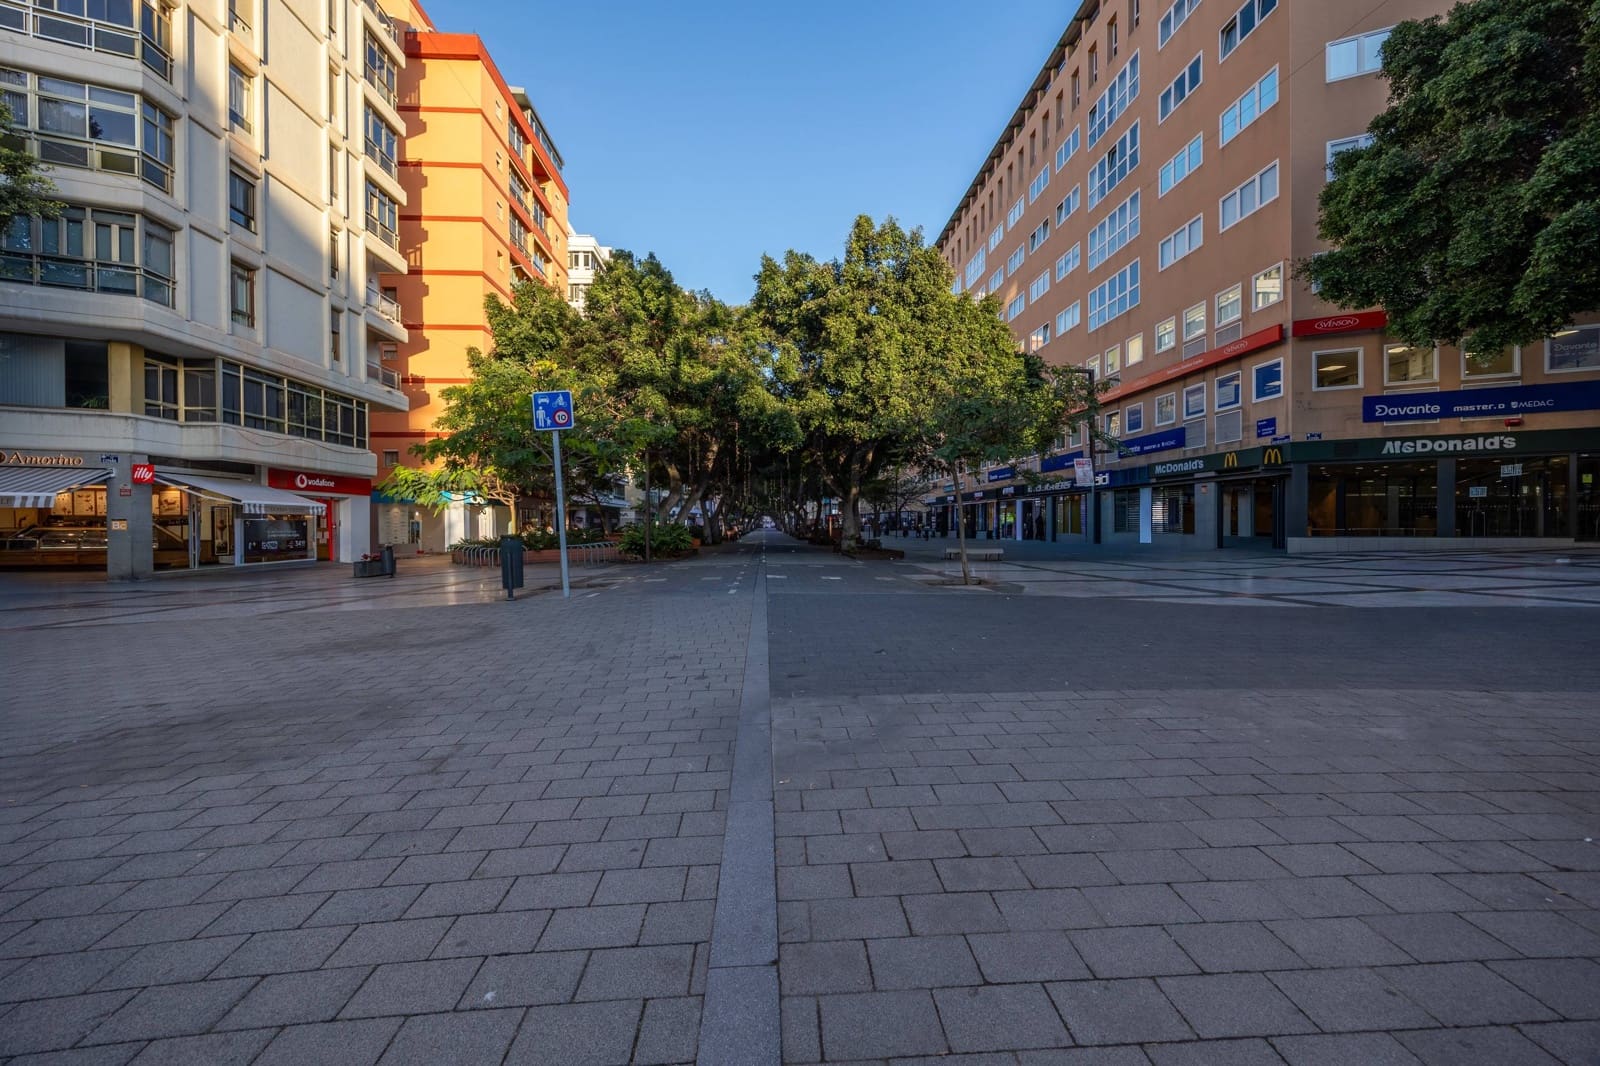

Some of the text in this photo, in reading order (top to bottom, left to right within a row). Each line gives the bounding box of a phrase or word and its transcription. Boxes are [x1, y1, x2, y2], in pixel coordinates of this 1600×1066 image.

[1375, 404, 1441, 416] Davante
[1518, 399, 1554, 408] MEDAC
[1382, 436, 1516, 453] McDonald's
[8, 451, 83, 465] Amorino
[134, 467, 153, 481] illy
[1155, 460, 1204, 474] McDonald's
[308, 480, 335, 488] vodafone
